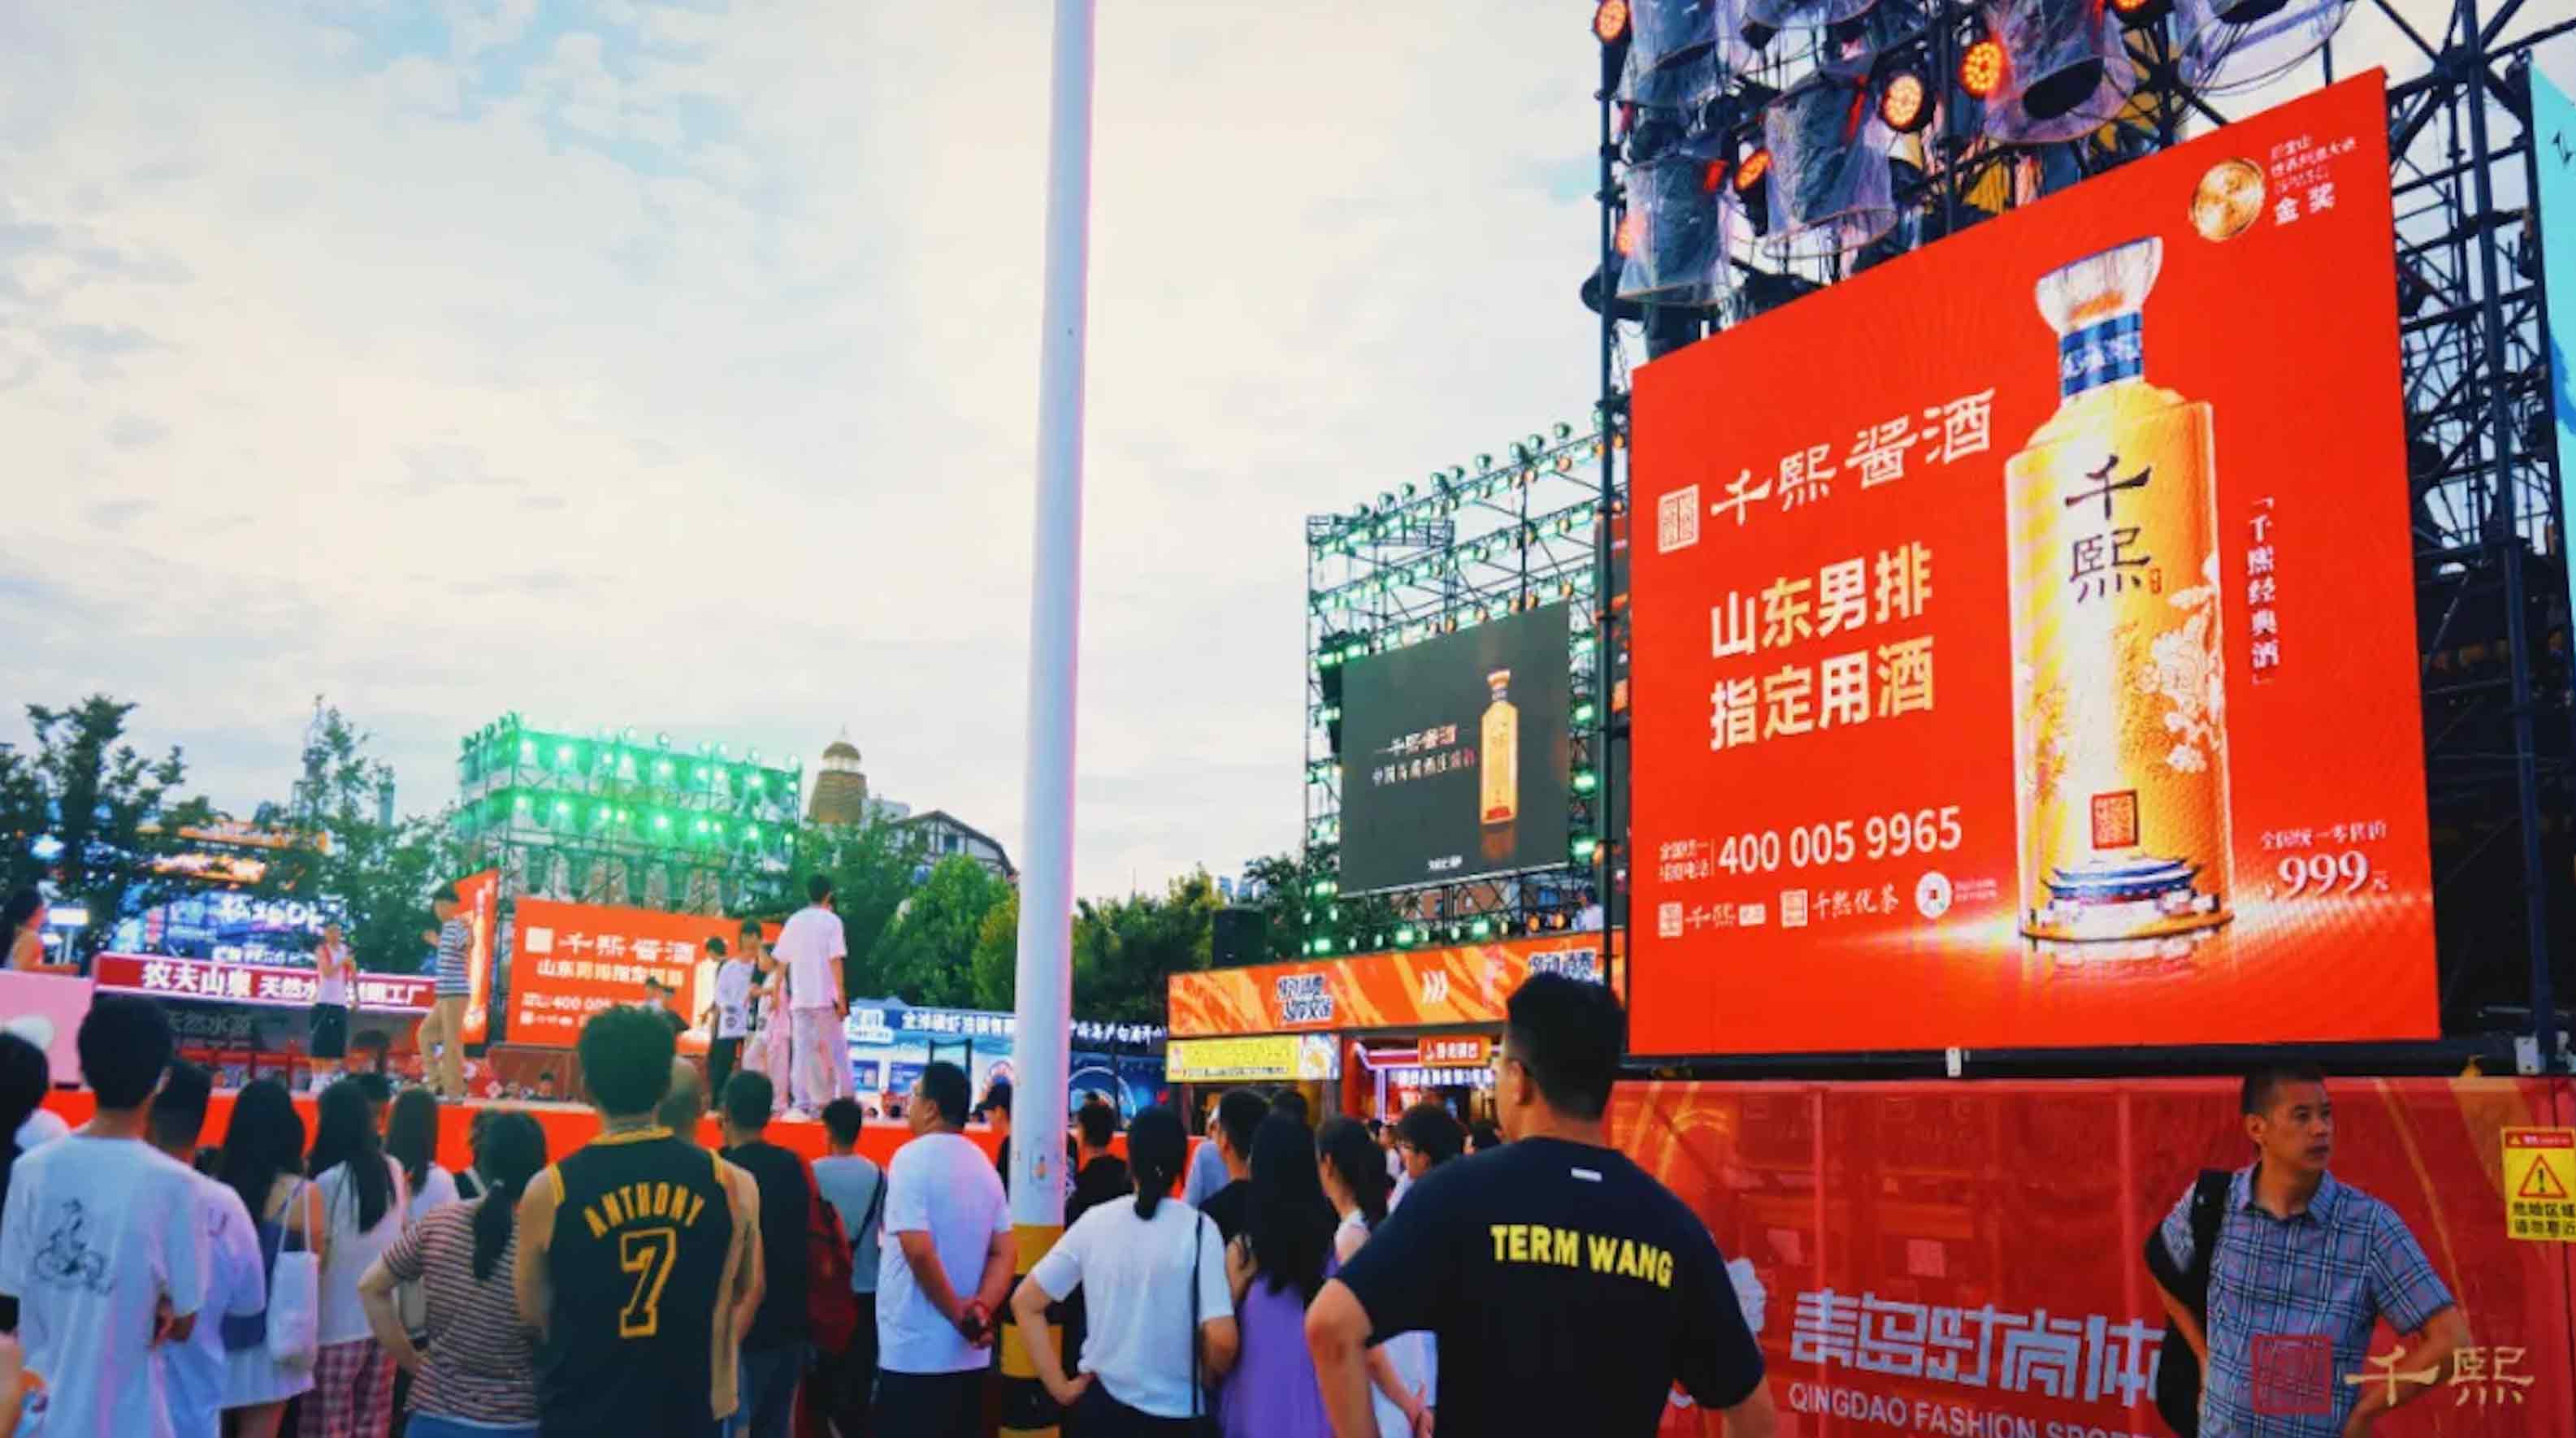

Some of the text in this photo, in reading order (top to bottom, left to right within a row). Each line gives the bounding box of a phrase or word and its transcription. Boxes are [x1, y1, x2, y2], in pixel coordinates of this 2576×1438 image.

[2275, 182, 2335, 226] 金奖
[1711, 388, 1996, 526] 千熙酱酒
[2065, 454, 2152, 604] 千熙
[1711, 541, 1933, 660] 山东男排
[1710, 635, 1935, 752] 指定用酒
[1719, 806, 1962, 876] 400 005 9965
[141, 961, 252, 997] 农夫山泉
[584, 1181, 705, 1240] ANTHONY
[2513, 1202, 2576, 1219] 危险区域
[619, 1226, 677, 1338] 7
[1490, 1223, 1675, 1289] TERM WANG
[1789, 1382, 2036, 1438] QINGDAO FASHION
